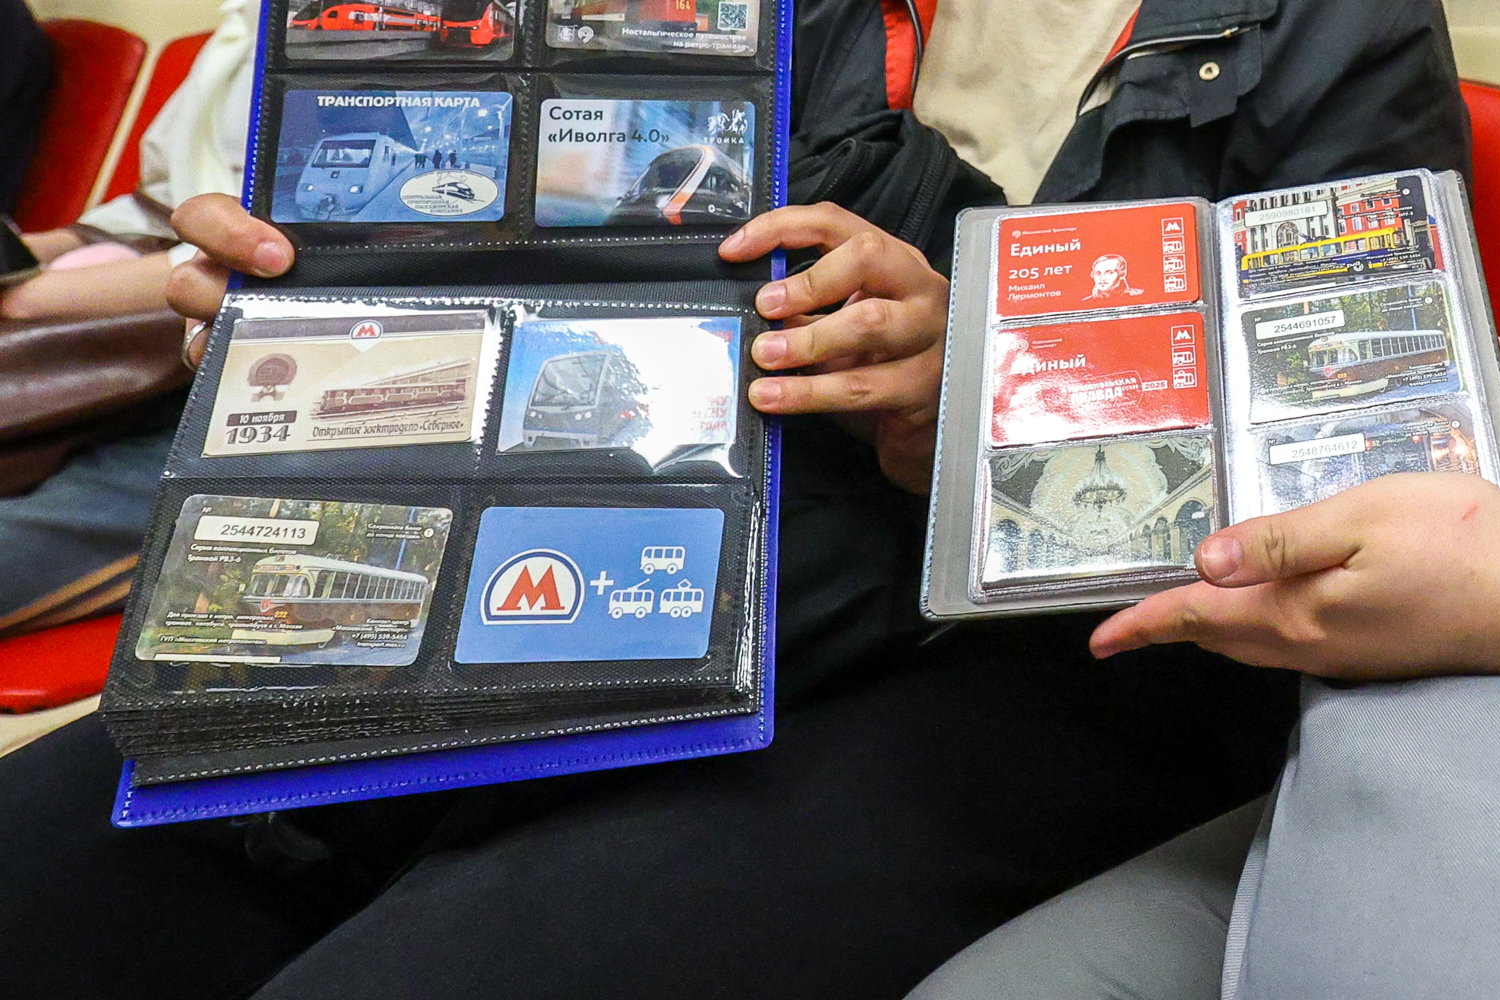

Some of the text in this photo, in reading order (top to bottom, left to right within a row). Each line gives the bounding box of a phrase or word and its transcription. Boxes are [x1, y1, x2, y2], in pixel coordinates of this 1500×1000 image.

[621, 26, 694, 39] Ностальгическое
[317, 95, 481, 108] ТРАНСПОРТНАЯ КАРТА
[548, 106, 603, 121] Сотая
[548, 128, 670, 144] «Иволга 4.0»
[703, 136, 745, 144] ТРОЙКА
[1259, 205, 1316, 221] 2590980181
[1010, 238, 1081, 258] Единый
[1008, 264, 1073, 279] 205 лет
[1008, 282, 1045, 292] Михаил
[1007, 290, 1062, 301] Лермонтов
[356, 324, 377, 338] М
[1274, 315, 1336, 334] 2544691057
[1010, 353, 1087, 376] диный
[1067, 377, 1137, 393] КОМСОМОЛЬСКАЯ
[1070, 387, 1123, 404] ПРАВДА
[239, 411, 285, 424] 10 ноября
[226, 424, 291, 444] 1934
[312, 419, 464, 438] Открытие электродепо «Северное»
[1292, 440, 1358, 459] 2548764612
[220, 524, 306, 539] 2544724113
[496, 563, 565, 611] М
